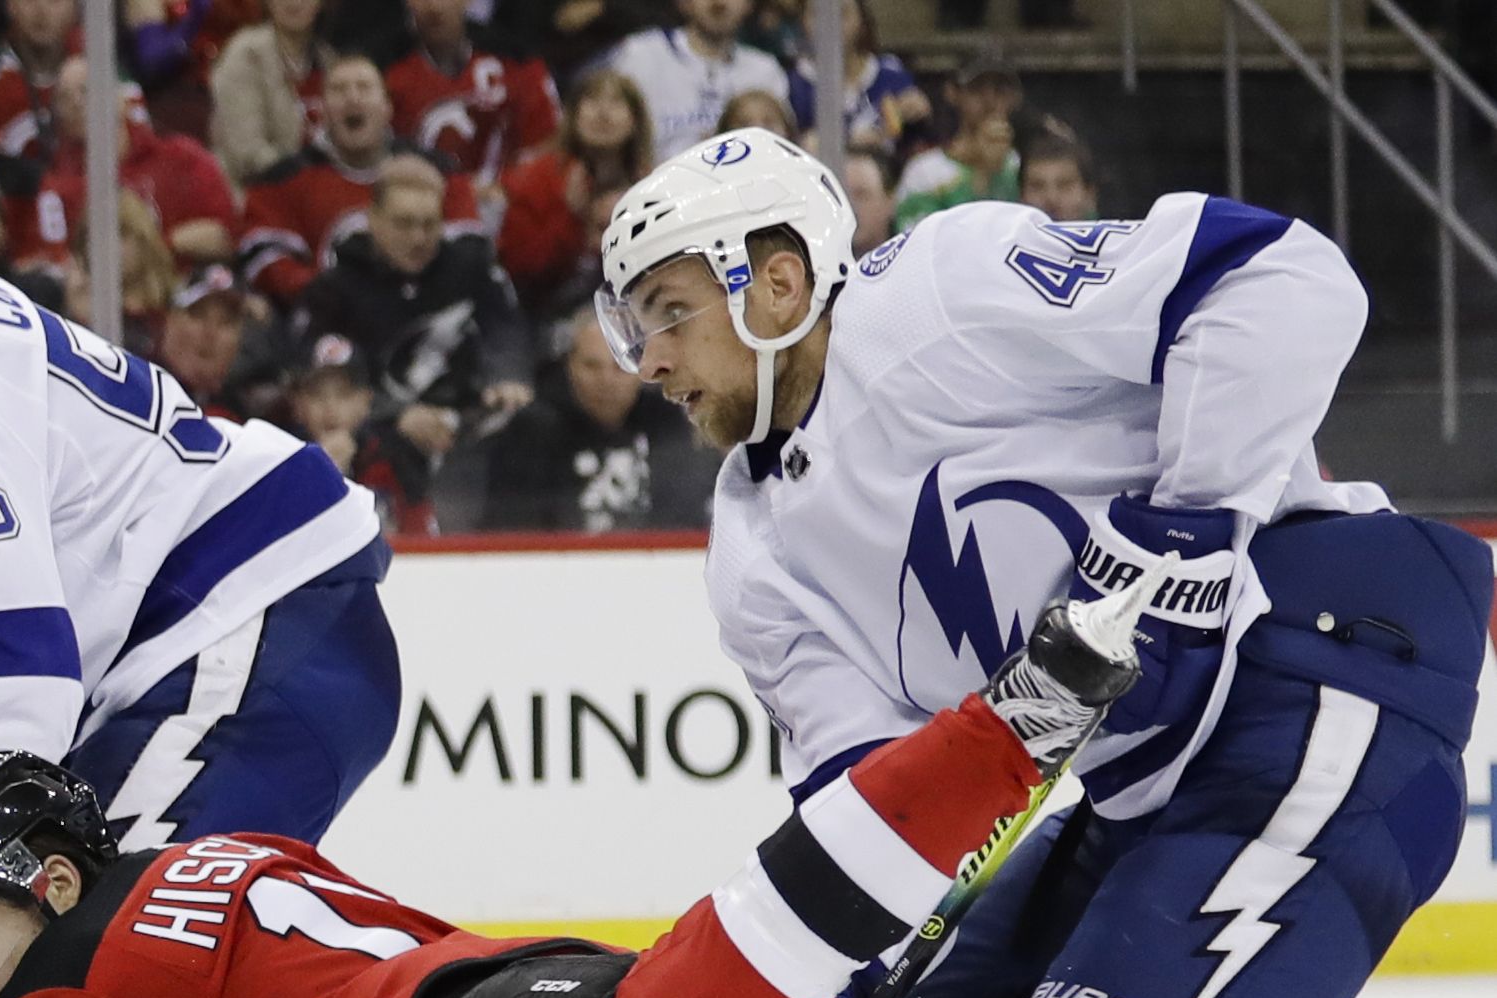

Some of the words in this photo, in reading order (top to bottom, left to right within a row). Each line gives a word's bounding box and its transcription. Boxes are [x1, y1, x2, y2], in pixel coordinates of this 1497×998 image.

[133, 837, 285, 950] HISC
[530, 979, 582, 993] CCM
[886, 957, 910, 986] RUTTA
